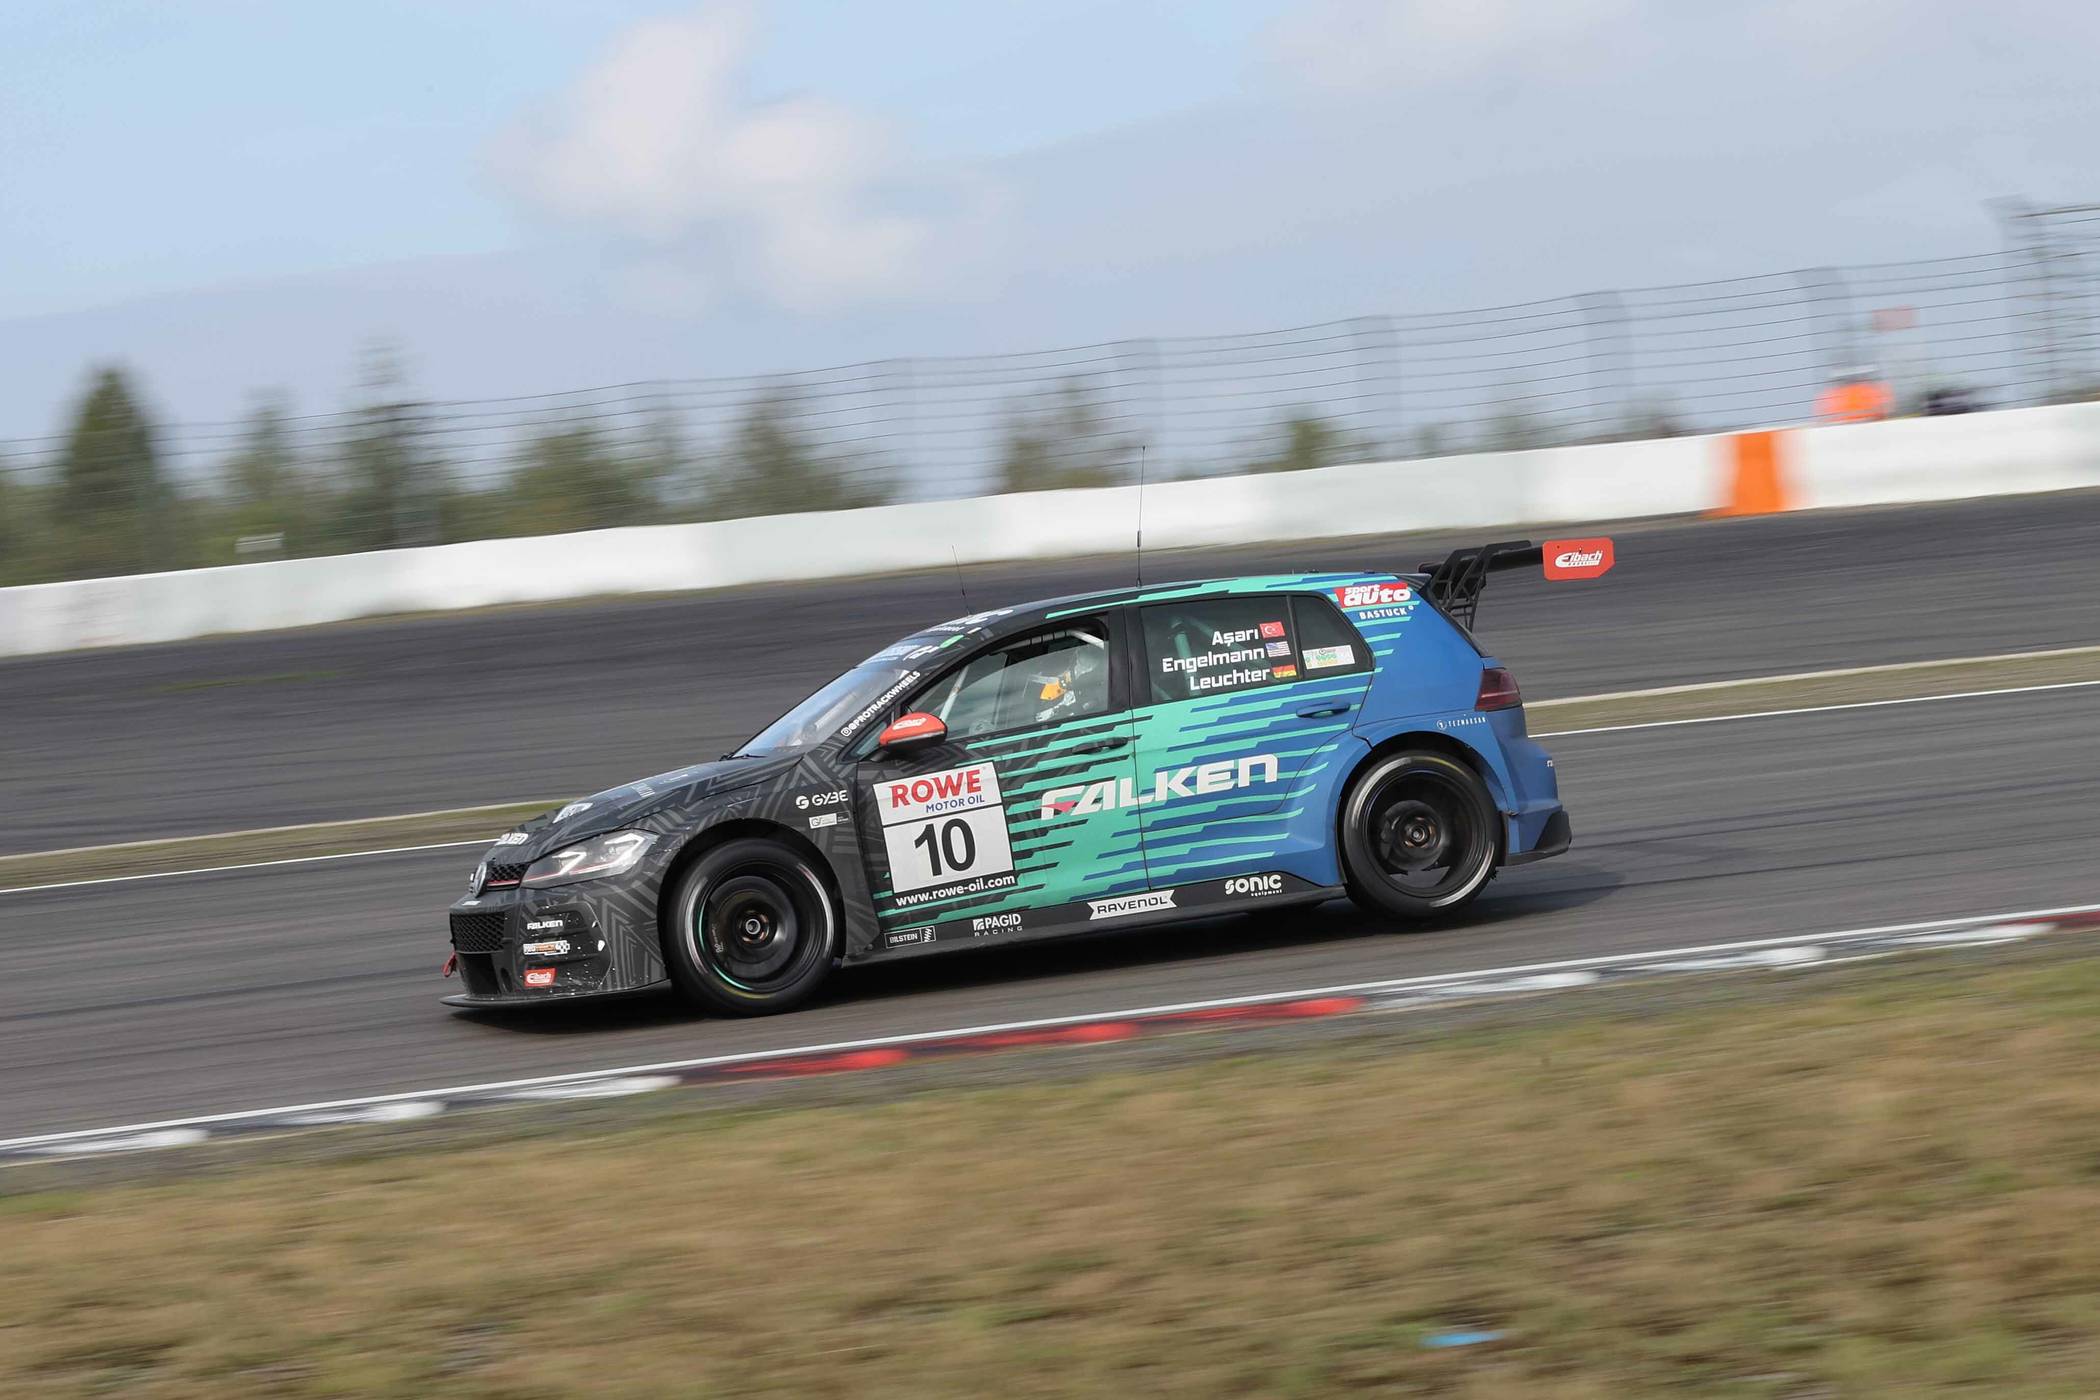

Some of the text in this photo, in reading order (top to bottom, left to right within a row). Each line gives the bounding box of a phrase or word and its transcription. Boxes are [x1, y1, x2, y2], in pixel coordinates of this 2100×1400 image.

[1555, 550, 1603, 567] Eibach
[1344, 588, 1411, 606] auto
[1345, 584, 1380, 595] sport
[1360, 608, 1407, 619] BASTUCK
[1212, 628, 1259, 647] Aşarı
[1162, 647, 1265, 673] Engelmann
[1190, 667, 1271, 690] Leuchter
[891, 769, 981, 808] ROWE
[1040, 754, 1278, 820] FALKEN
[926, 795, 985, 813] MOTOR OIL
[914, 819, 976, 877] 10
[896, 874, 1015, 906] www.rowe-oil.com
[1097, 897, 1168, 915] RAVENOL
[985, 914, 1021, 929] PAGID
[975, 926, 1022, 936] RACING
